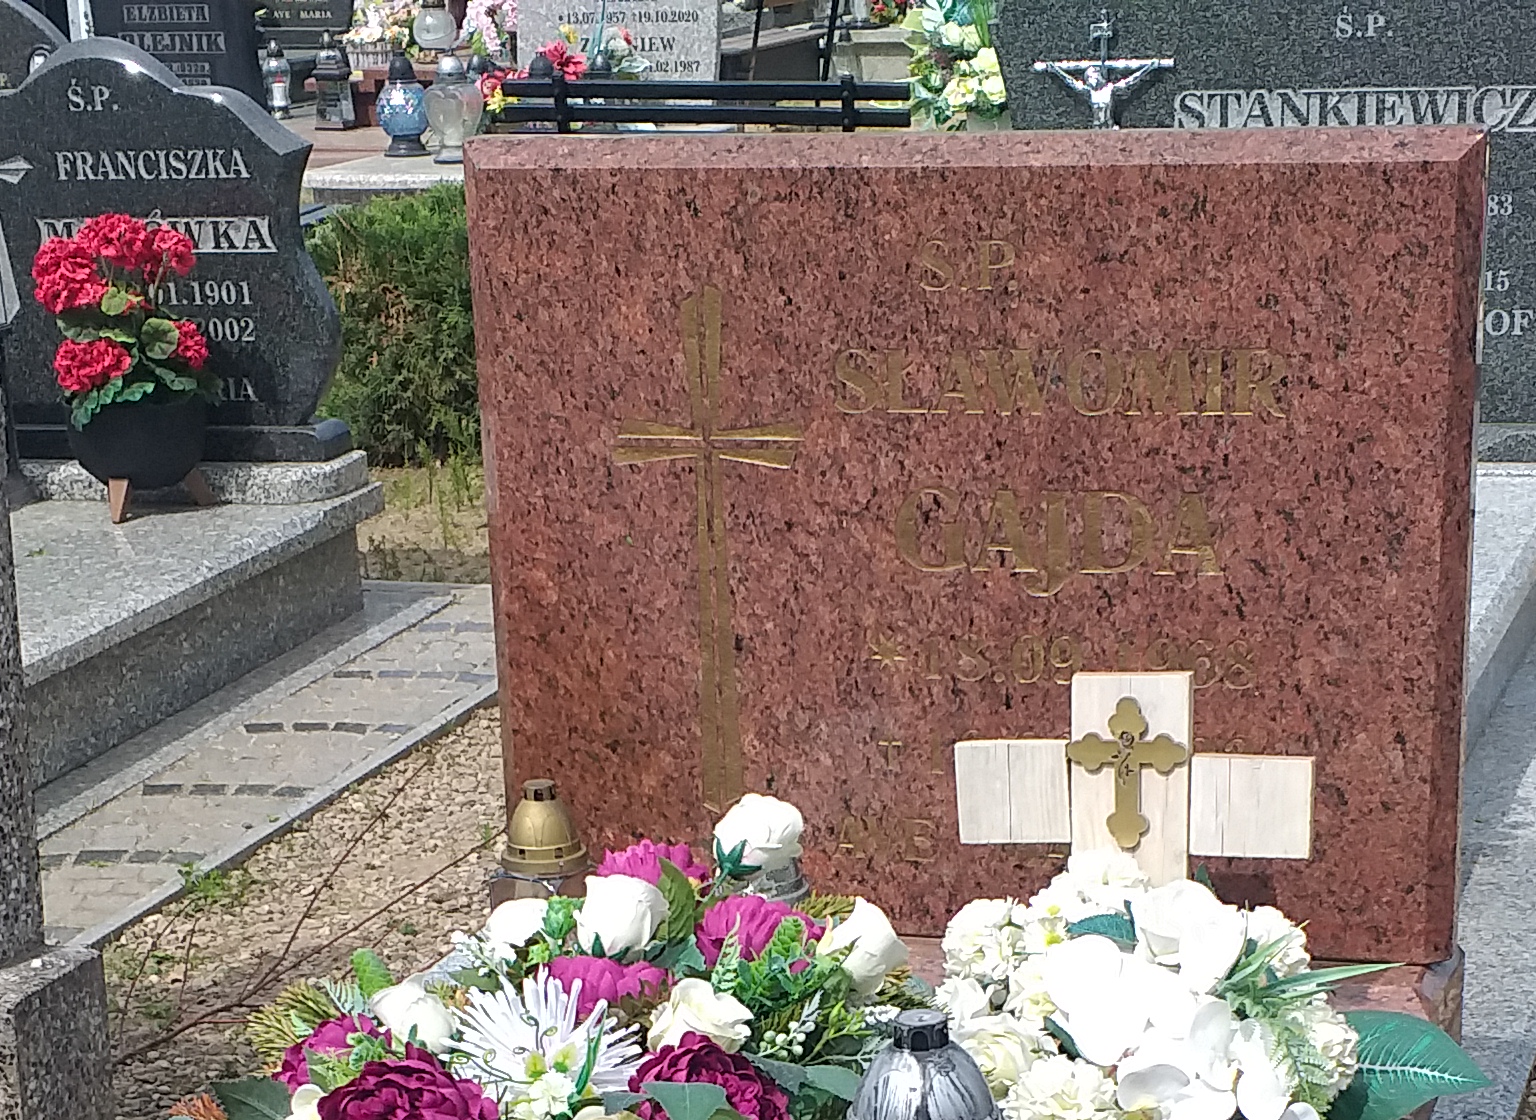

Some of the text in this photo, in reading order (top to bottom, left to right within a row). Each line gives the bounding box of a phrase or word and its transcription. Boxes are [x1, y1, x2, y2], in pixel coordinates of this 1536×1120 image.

[1335, 6, 1393, 38] Ś.P.
[67, 78, 120, 111] Ś.P.
[56, 149, 251, 182] FRANCISZKA
[919, 224, 1018, 291] Ś.P.
[833, 346, 1287, 418] SŁAWOMIR
[894, 486, 1224, 597] GAJDA
